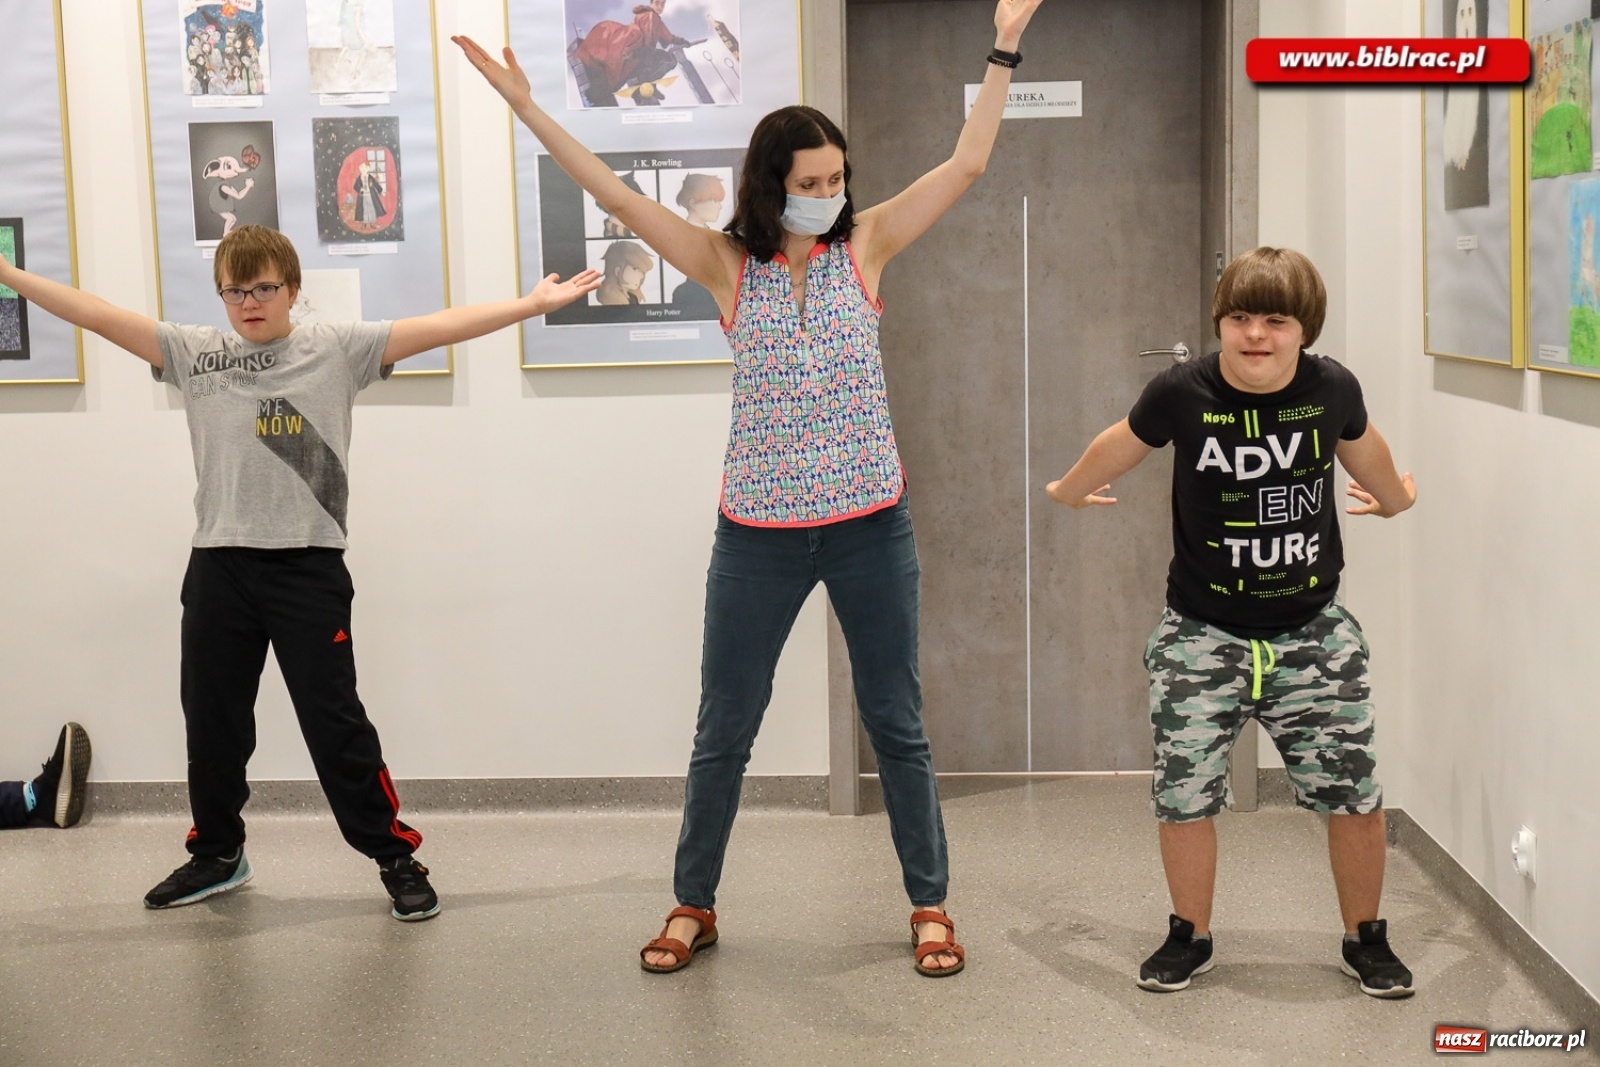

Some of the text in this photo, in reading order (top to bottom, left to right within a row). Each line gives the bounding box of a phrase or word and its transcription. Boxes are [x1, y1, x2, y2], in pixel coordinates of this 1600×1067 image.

[633, 158, 683, 168] J. K. Rowling
[646, 308, 681, 317] Harry Potter
[190, 350, 276, 376] NOTHING
[189, 369, 260, 400] CAN STOP
[256, 397, 284, 417] ME
[256, 415, 303, 437] NOW
[1196, 431, 1303, 481] ADV
[1259, 478, 1324, 525] EN
[1224, 532, 1320, 568] TURE
